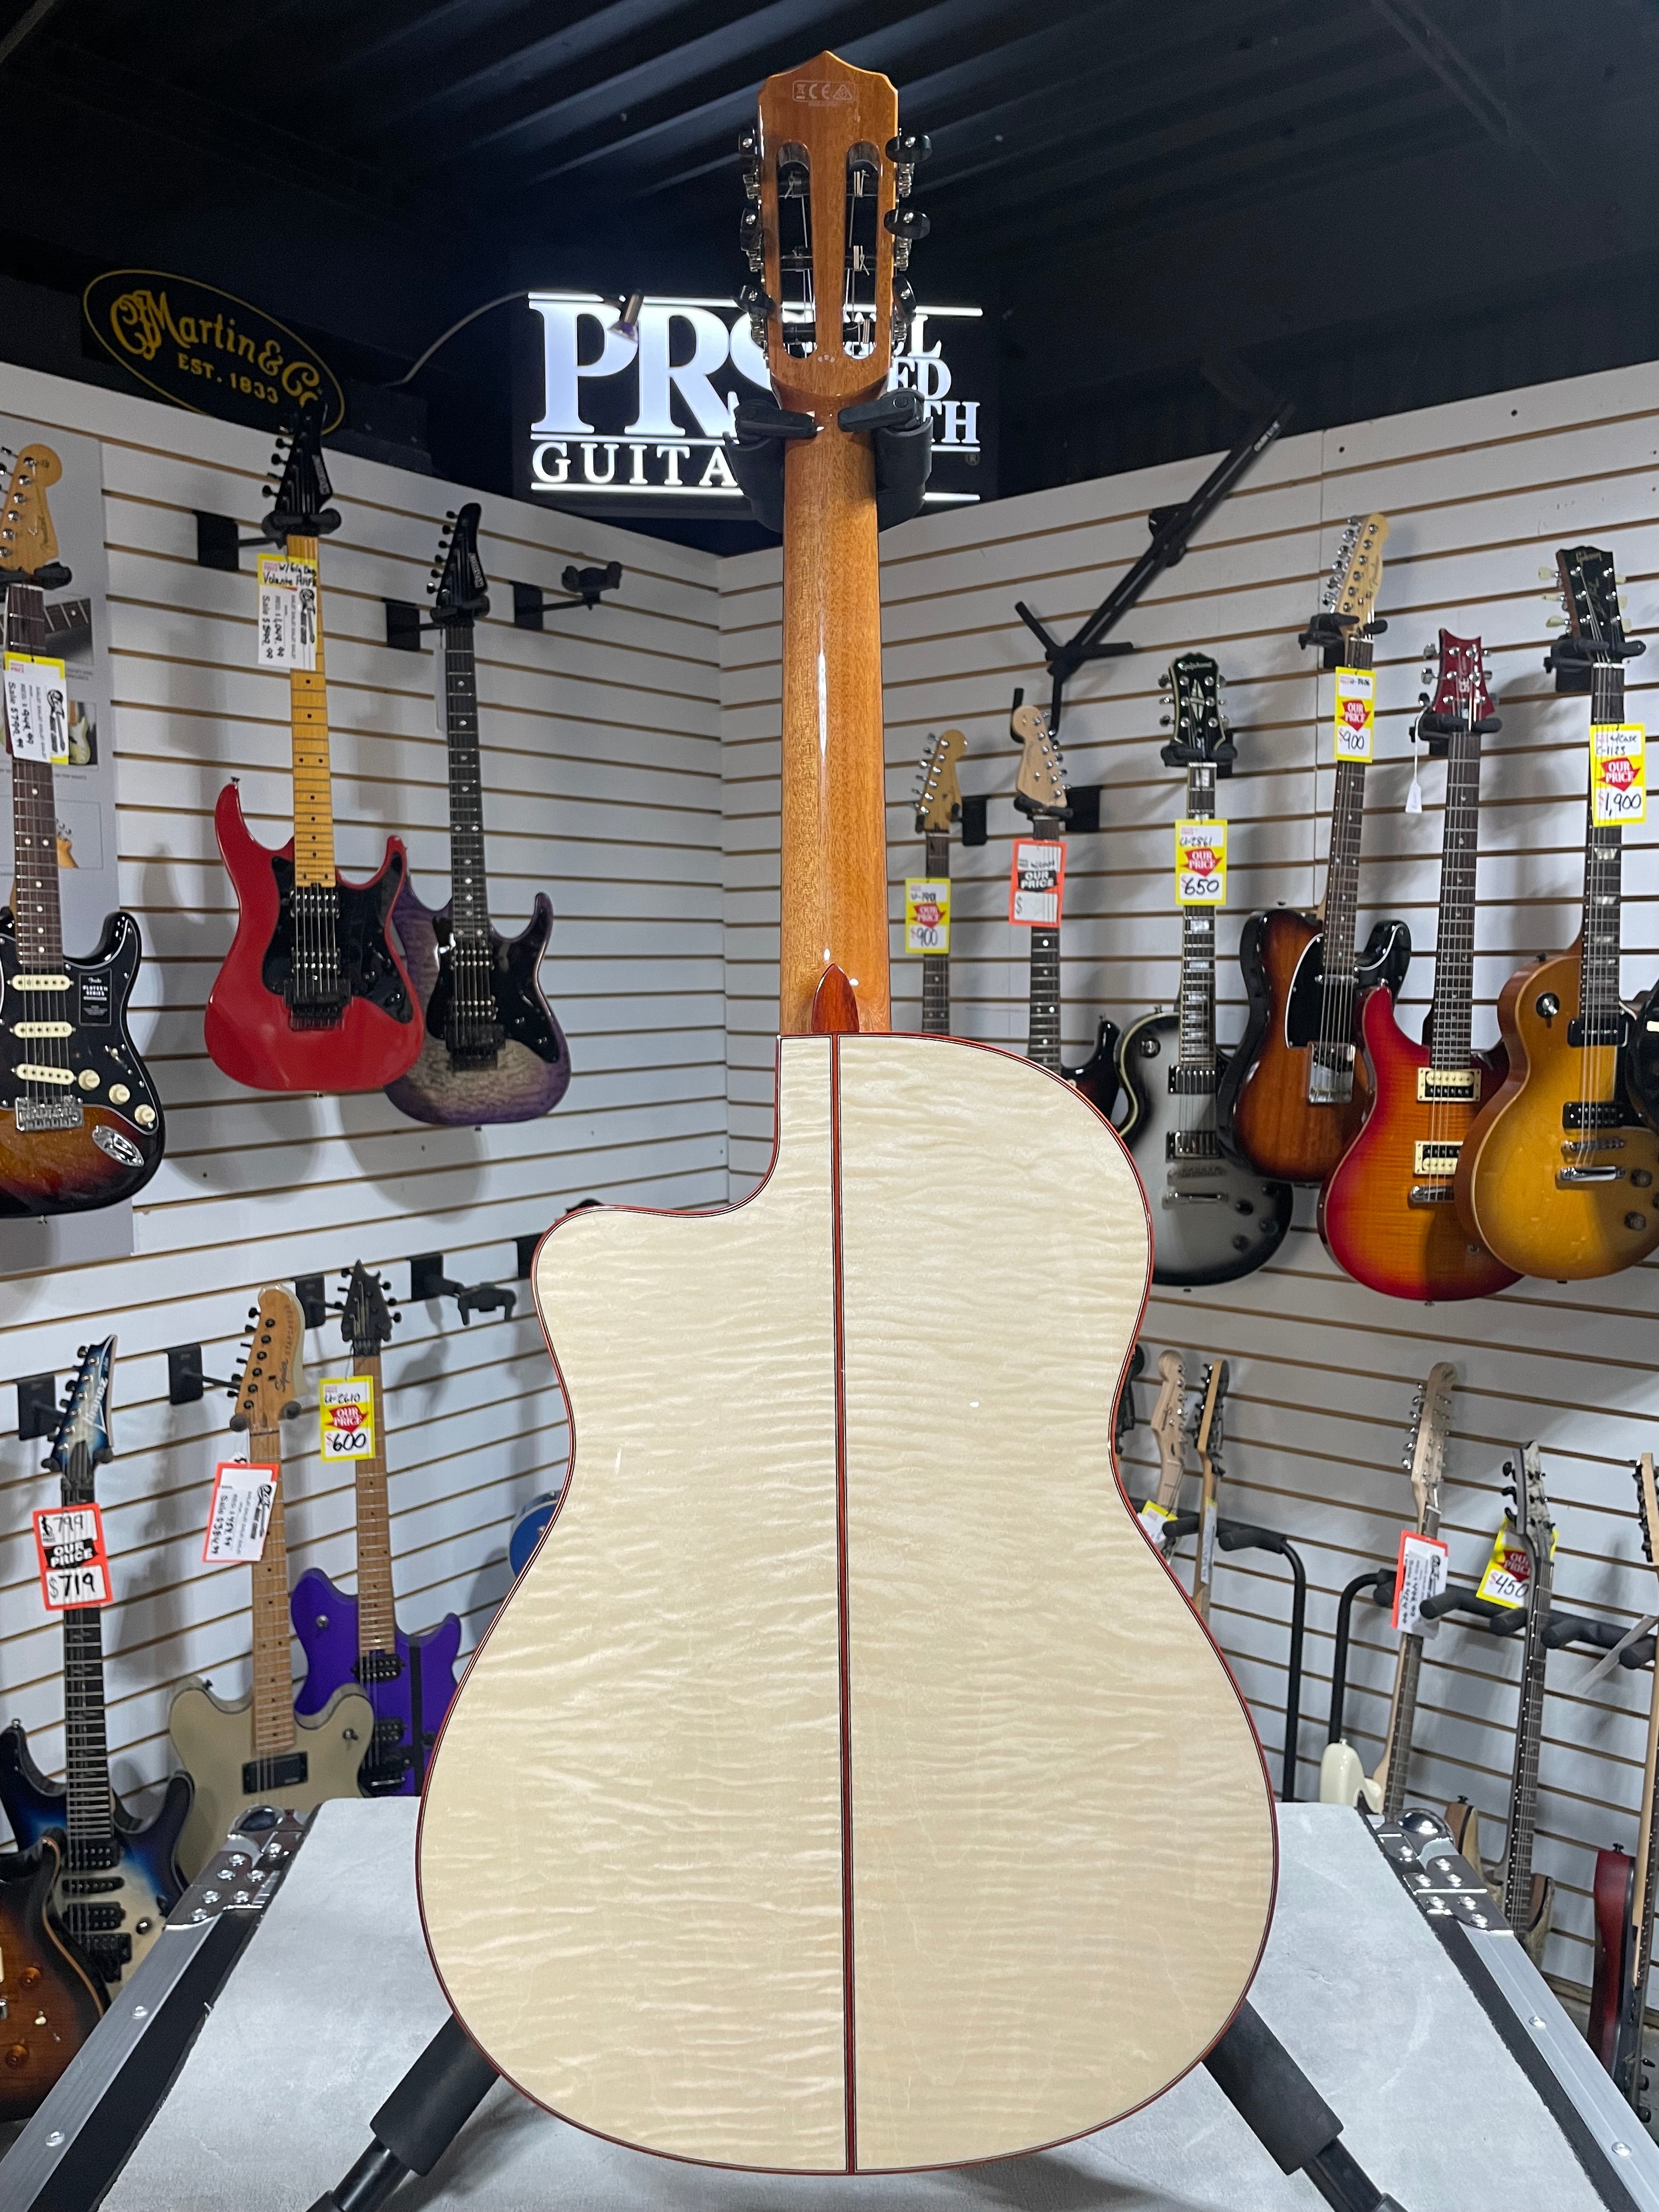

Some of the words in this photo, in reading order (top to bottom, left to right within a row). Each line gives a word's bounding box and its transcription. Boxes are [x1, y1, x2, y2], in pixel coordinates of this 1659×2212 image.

[229, 372, 279, 404] 1833
[532, 442, 738, 486] GUITA
[1348, 702, 1363, 713] OUR
[1345, 712, 1366, 723] PRICE
[1608, 761, 1630, 772] OUR
[1606, 771, 1634, 783] PRICE
[1192, 851, 1212, 860] OUR
[1189, 860, 1216, 869] PRICE
[1024, 871, 1049, 880] OUR
[1021, 878, 1054, 889] PRICE
[336, 1408, 358, 1418] OUR
[334, 1417, 363, 1427] PRICE
[54, 1542, 84, 1556] OUR
[50, 1548, 94, 1568] PRICE
[49, 1572, 95, 1599] $719
